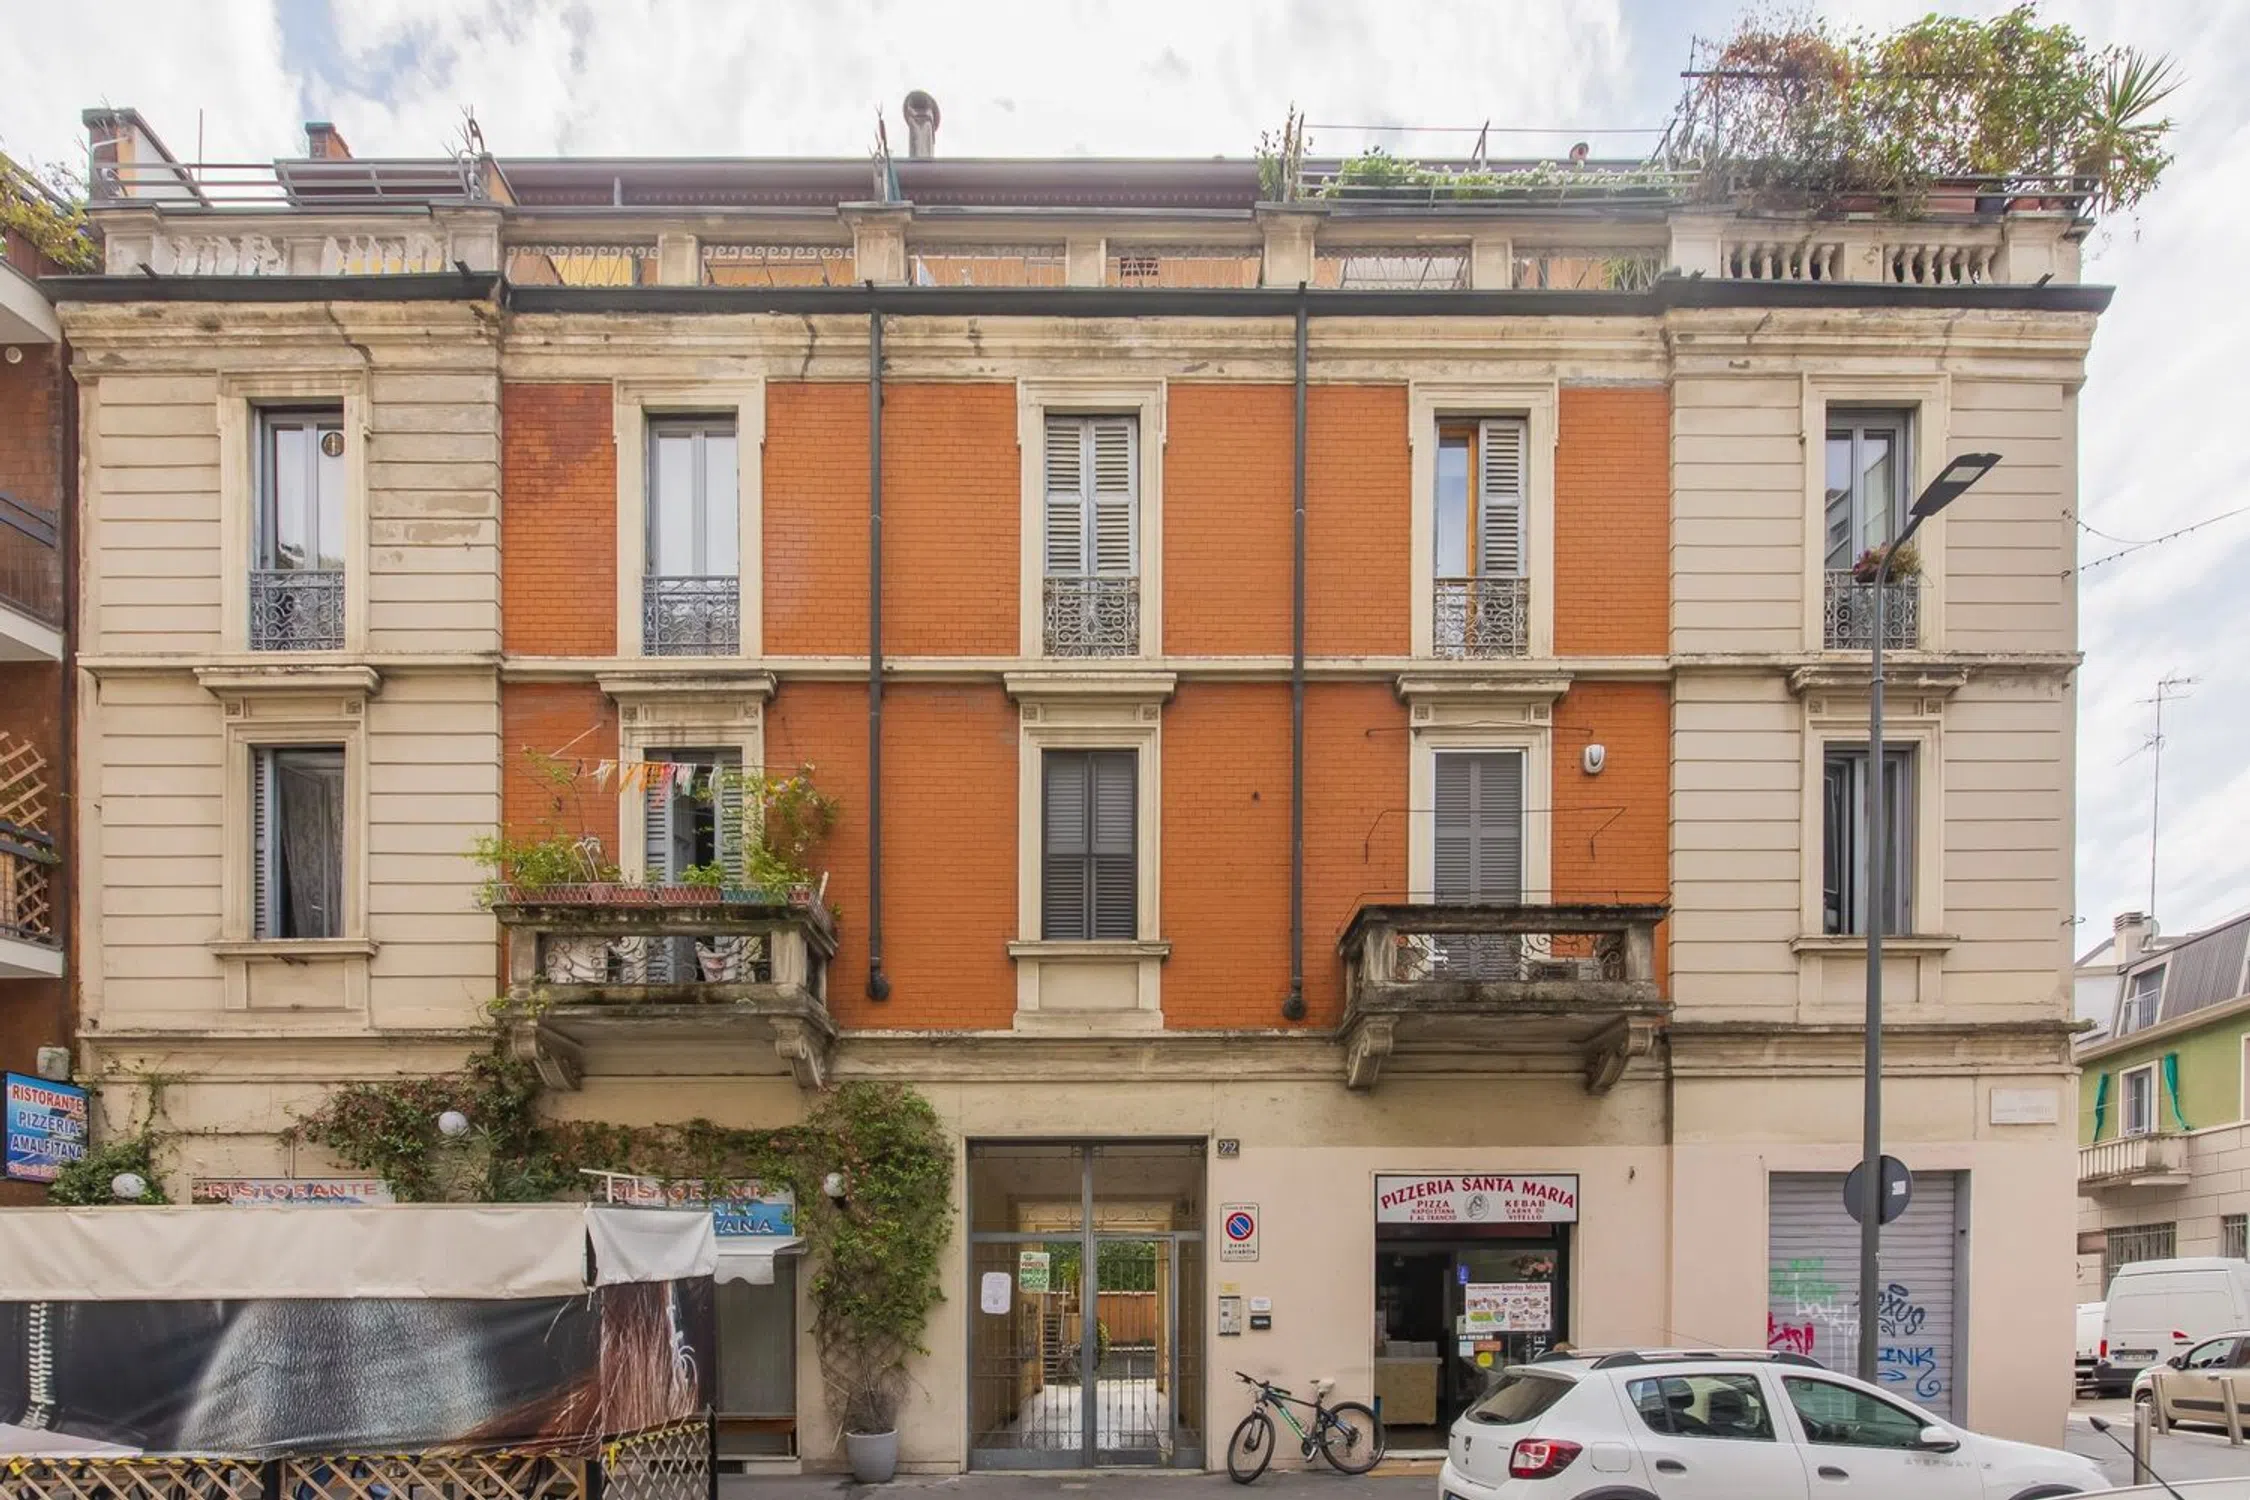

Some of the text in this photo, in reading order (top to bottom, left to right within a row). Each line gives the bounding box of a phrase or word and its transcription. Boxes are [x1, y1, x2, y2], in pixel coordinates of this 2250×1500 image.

[12, 1084, 85, 1115] RISTORANTE
[18, 1110, 79, 1135] PIZZERIA
[11, 1134, 85, 1159] AMALFITANA
[1219, 1141, 1237, 1154] 22
[208, 1182, 378, 1199] RISTORANTE
[1380, 1178, 1575, 1209] PIZZERIA SANTA MARIA
[1417, 1199, 1450, 1208] PIZZA
[1505, 1200, 1545, 1208] KEBAB
